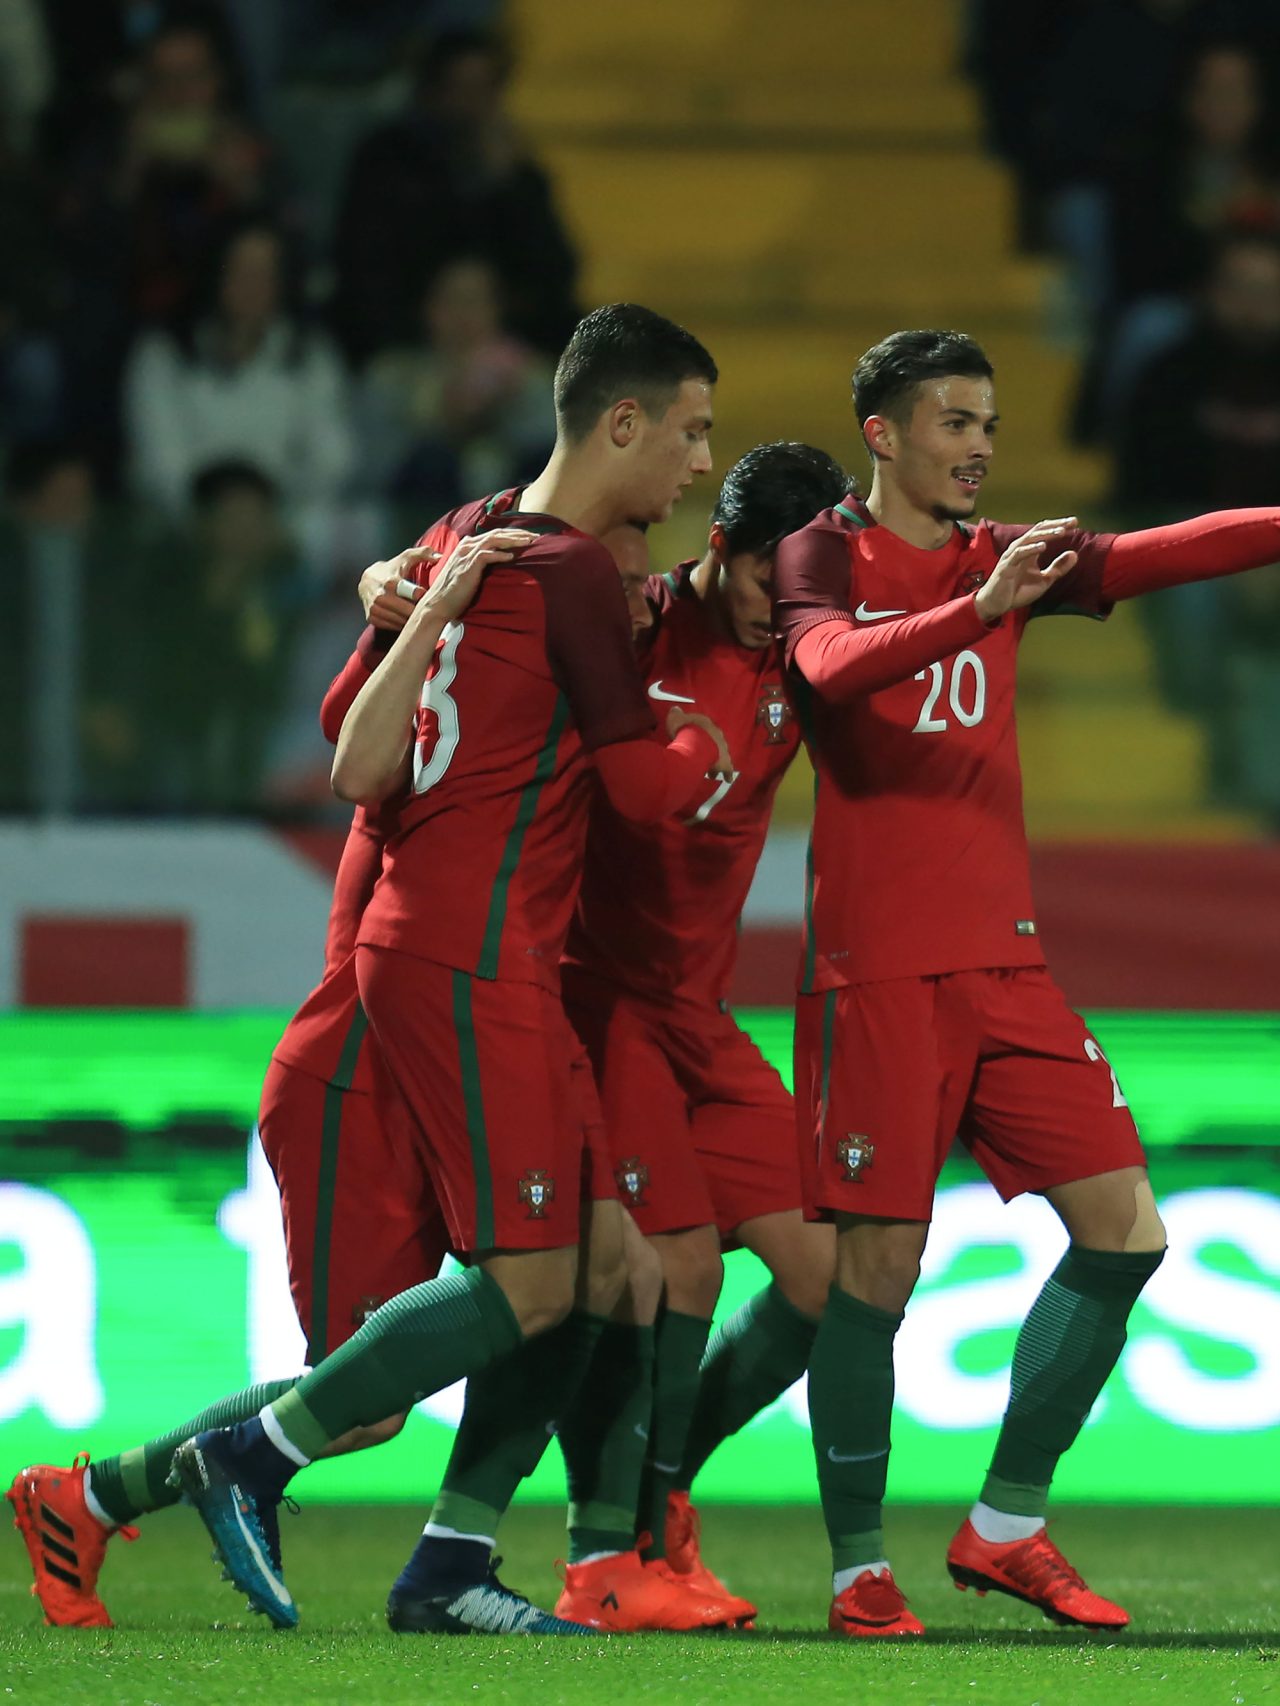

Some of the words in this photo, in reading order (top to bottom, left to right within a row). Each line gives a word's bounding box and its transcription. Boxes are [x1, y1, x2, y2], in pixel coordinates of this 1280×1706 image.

[911, 649, 986, 733] 20
[685, 771, 741, 826] 7
[1083, 1038, 1129, 1109] 2
